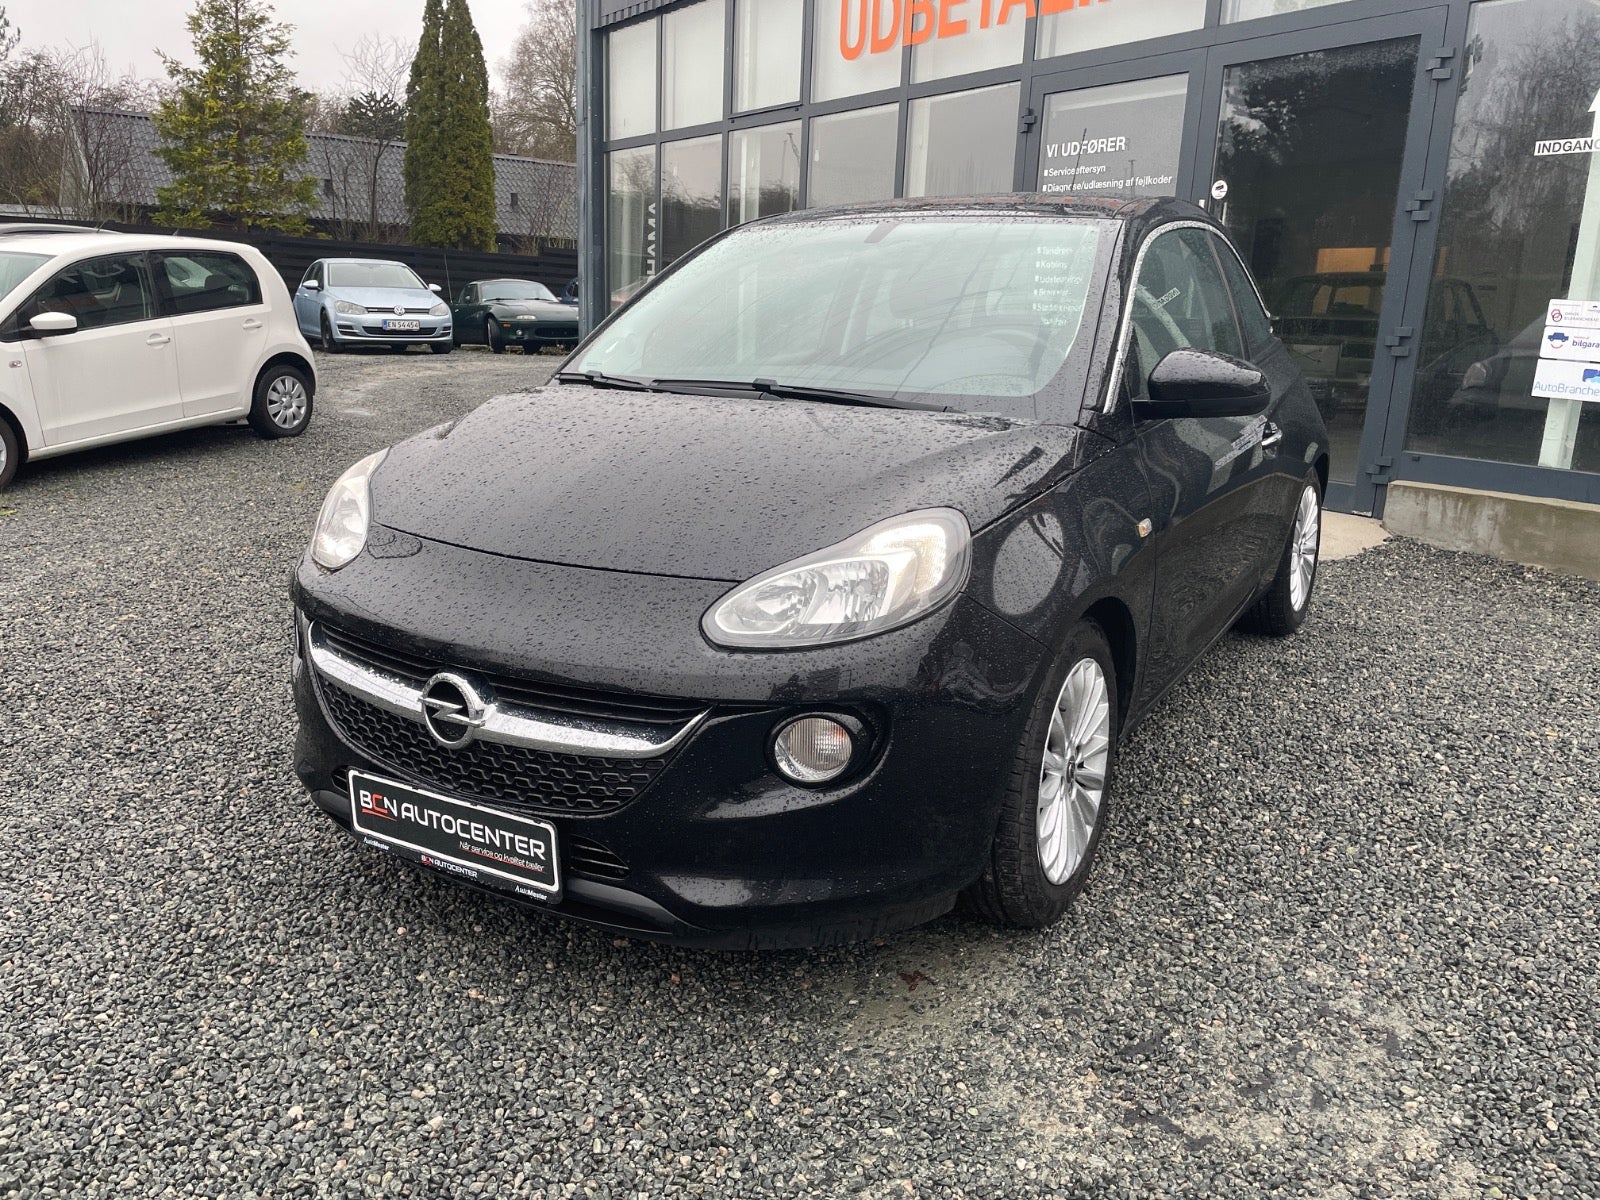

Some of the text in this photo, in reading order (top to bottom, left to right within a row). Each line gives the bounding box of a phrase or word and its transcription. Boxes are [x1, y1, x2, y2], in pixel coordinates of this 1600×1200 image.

[1046, 136, 1126, 158] VI UDFØRER
[1048, 165, 1106, 177] Serviceaftersyn
[1125, 177, 1134, 186] af
[1135, 174, 1173, 187] fejlkoder
[1533, 381, 1600, 397] AutoBranche
[360, 789, 546, 861] BCN AUTOCENTER
[470, 845, 494, 857] service
[494, 852, 503, 862] og
[434, 858, 478, 879] AUTOCENTER
